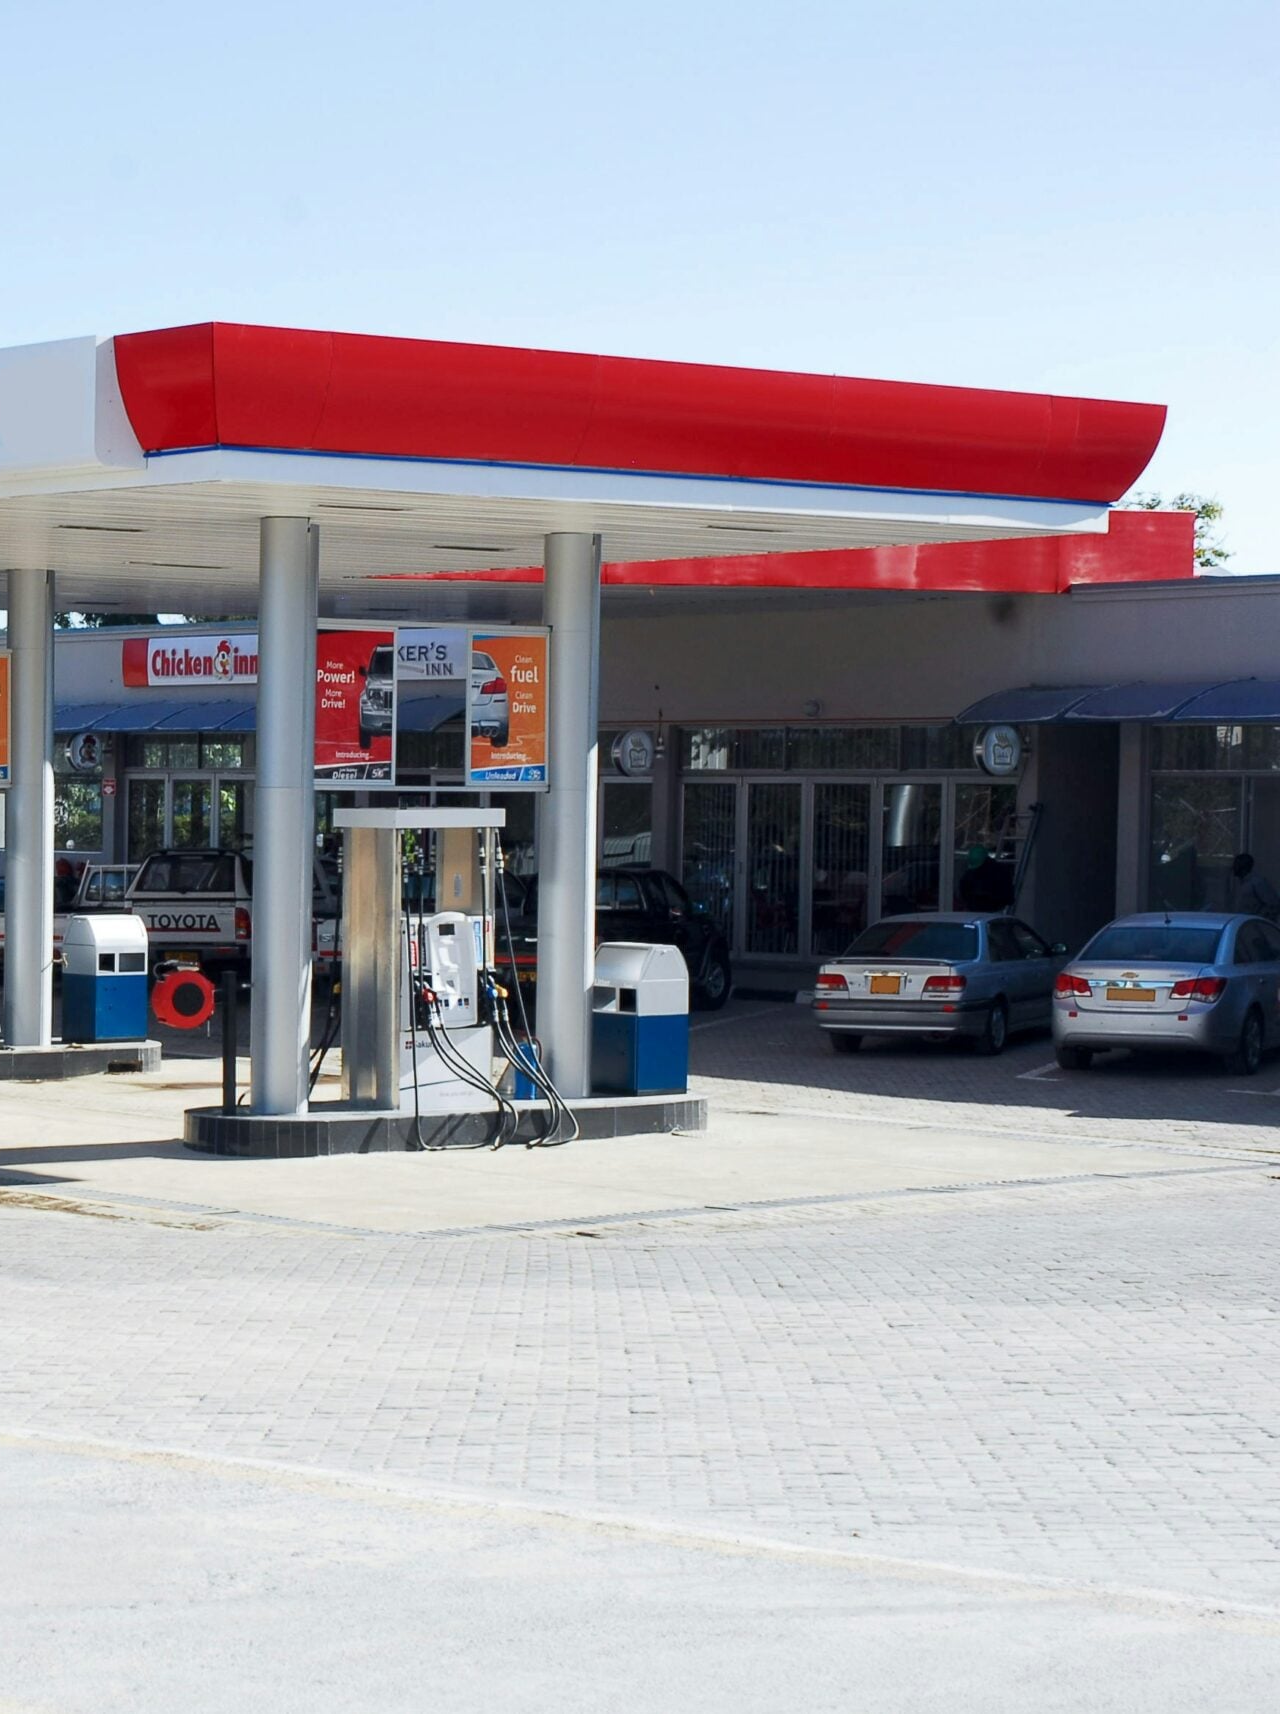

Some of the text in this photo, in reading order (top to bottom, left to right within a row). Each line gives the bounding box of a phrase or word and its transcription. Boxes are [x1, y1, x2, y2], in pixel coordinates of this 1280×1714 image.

[151, 646, 258, 677] Chicken inn
[515, 655, 533, 664] Clean
[326, 661, 343, 670] More
[426, 663, 454, 675] INN
[316, 669, 355, 683] Power!
[510, 665, 539, 683] fuel
[325, 689, 342, 697] More
[515, 691, 533, 700] Clean
[321, 698, 346, 709] Drive!
[512, 702, 537, 713] Drive
[147, 914, 220, 929] TOYOTA
